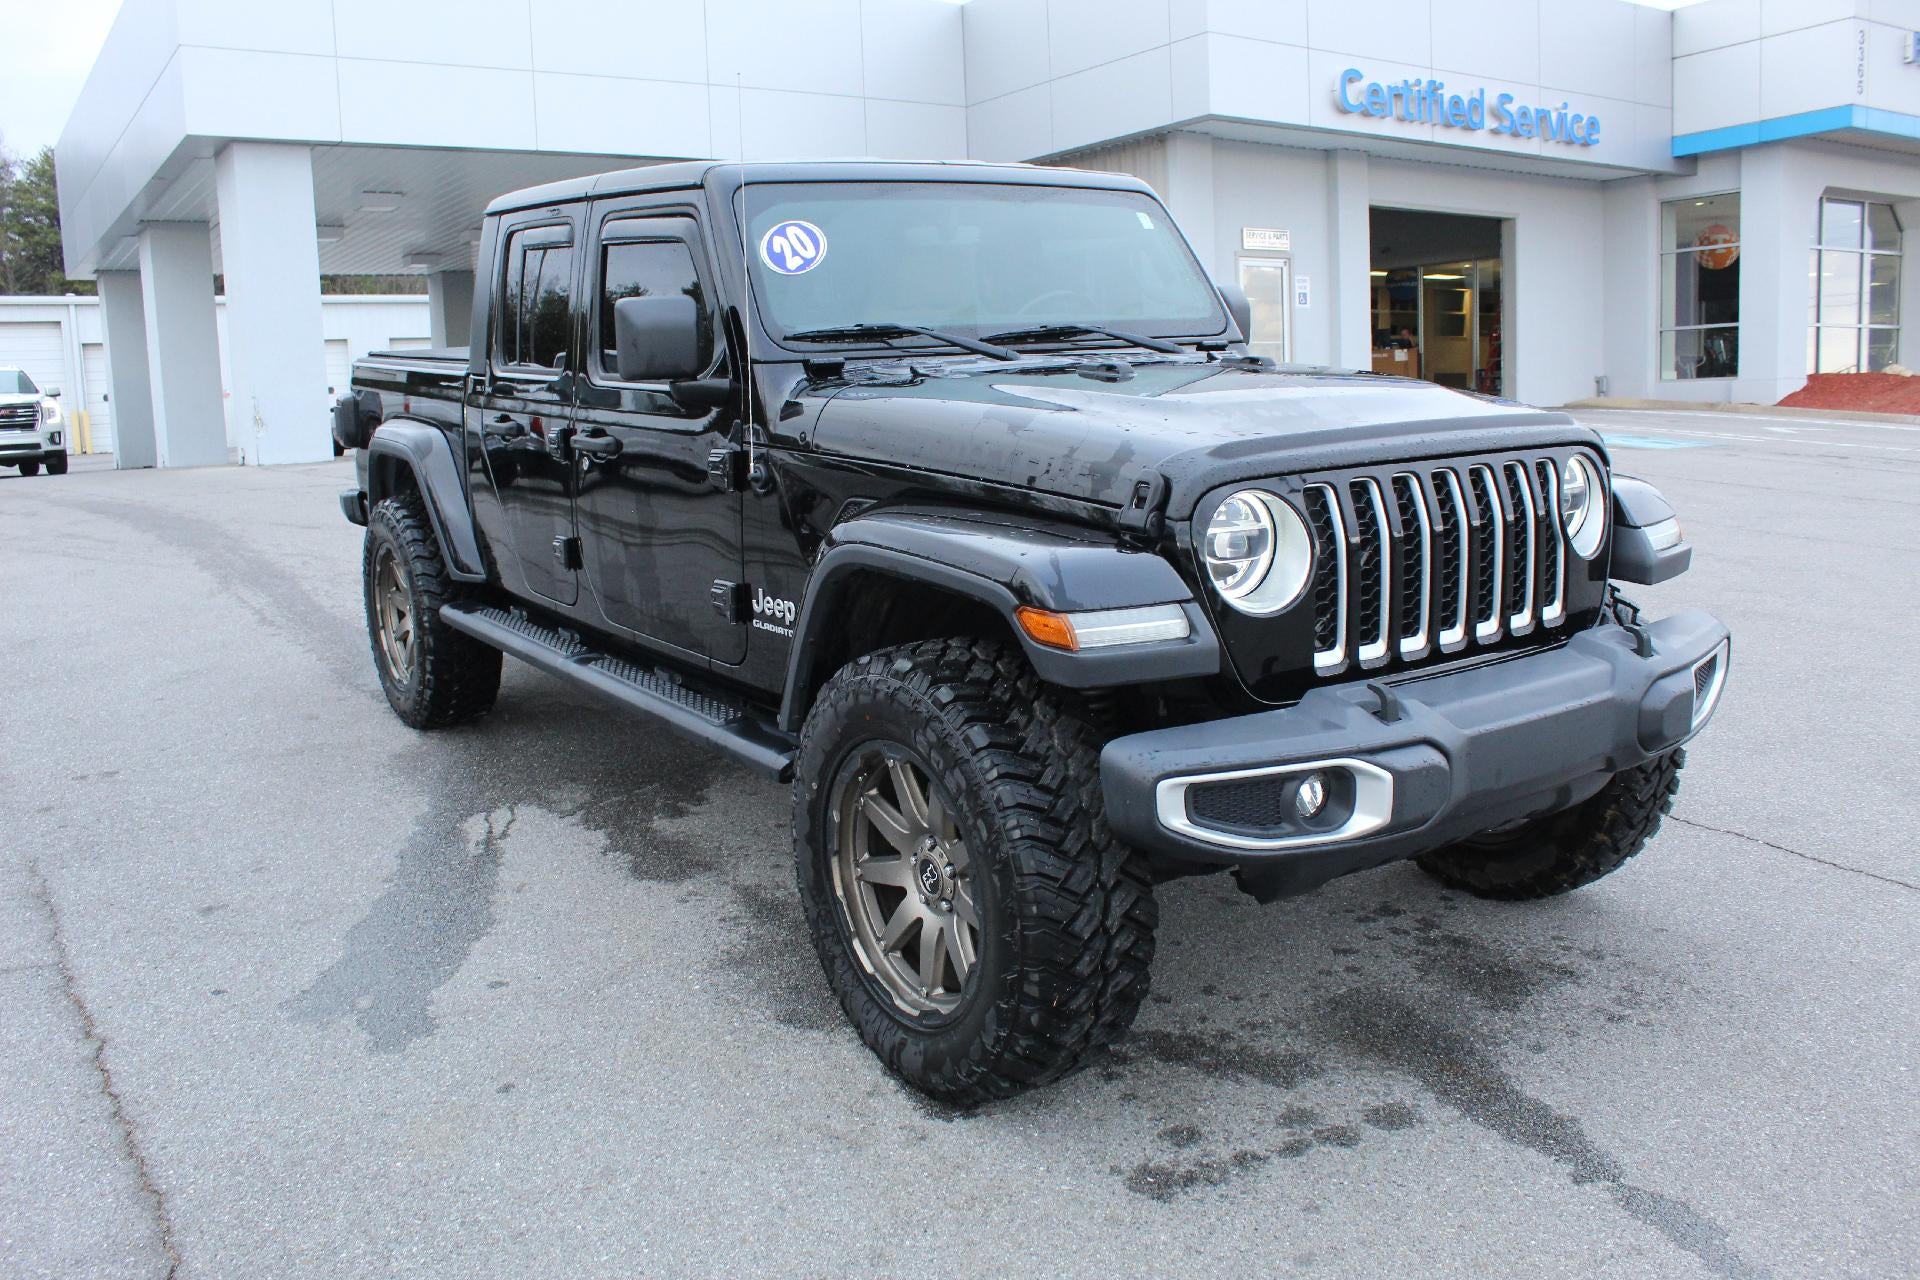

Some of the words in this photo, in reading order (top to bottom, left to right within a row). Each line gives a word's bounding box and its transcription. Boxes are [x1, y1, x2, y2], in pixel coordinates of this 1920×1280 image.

[1338, 68, 1485, 130] Certified
[1495, 93, 1600, 146] Service
[772, 226, 817, 271] 20
[1273, 232, 1289, 241] PARTS
[752, 588, 796, 626] Jeep
